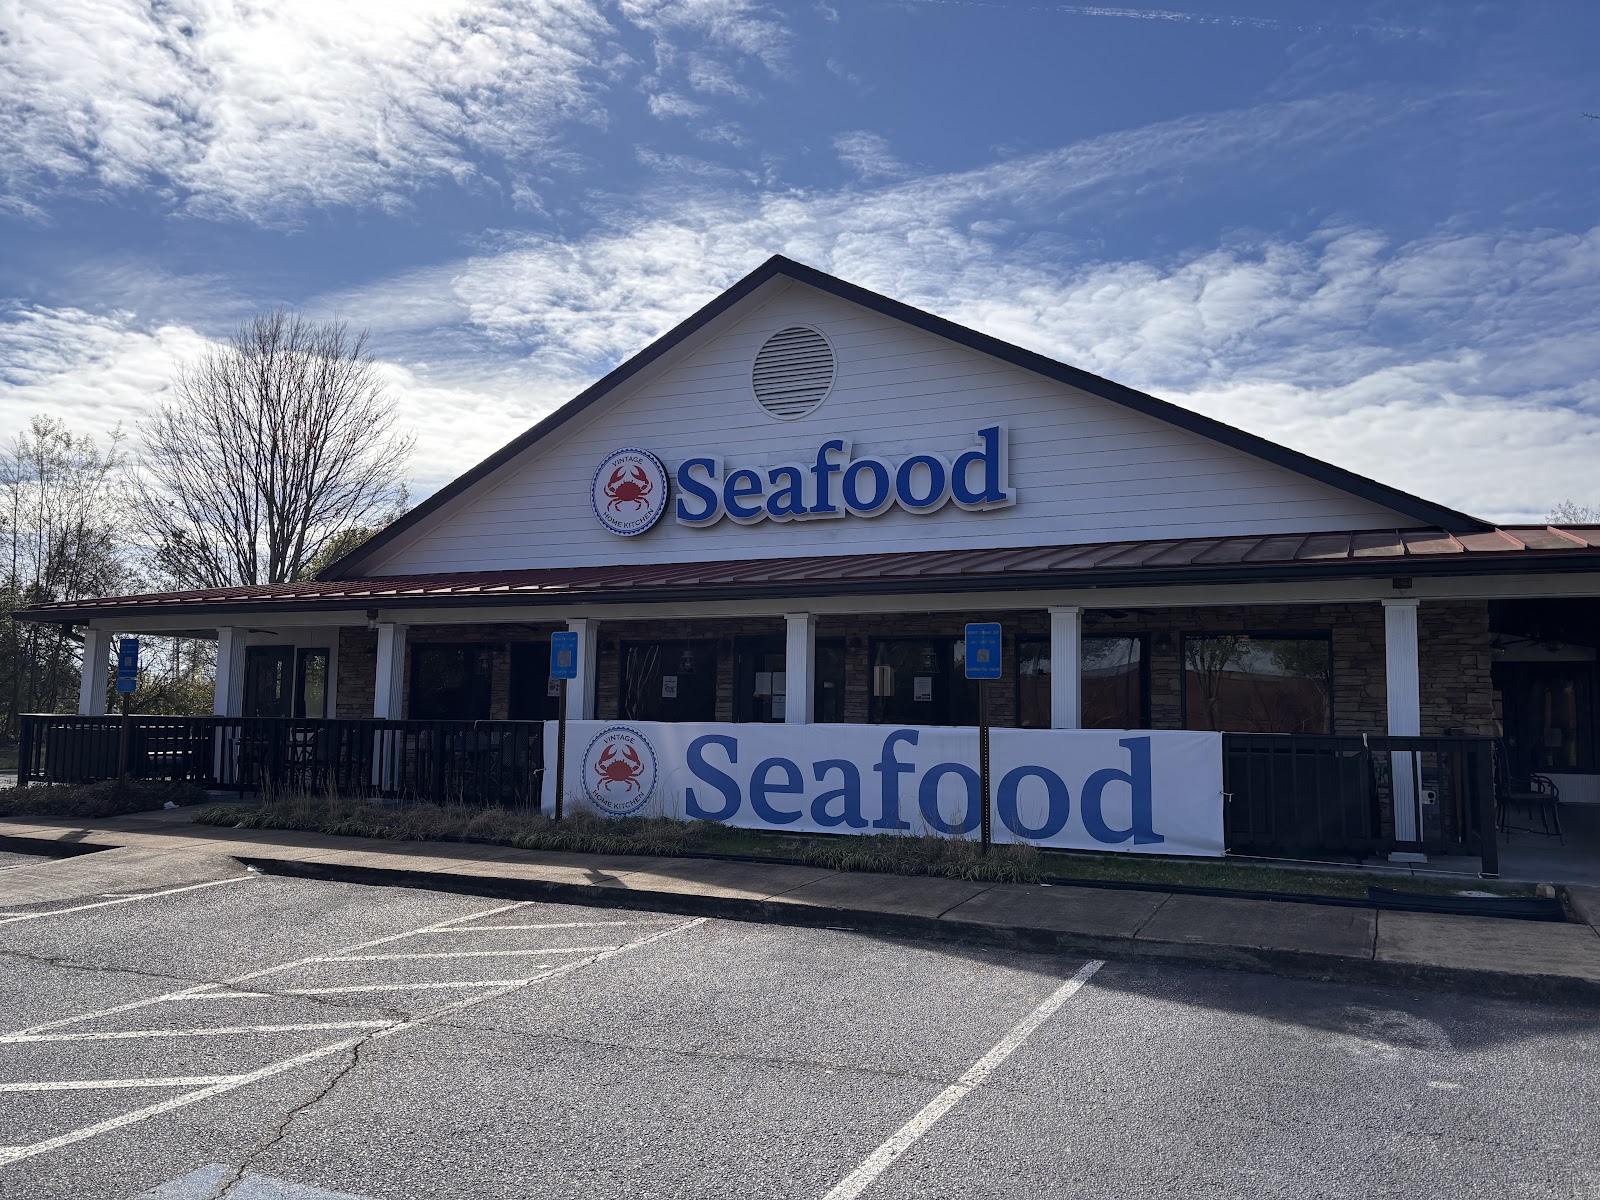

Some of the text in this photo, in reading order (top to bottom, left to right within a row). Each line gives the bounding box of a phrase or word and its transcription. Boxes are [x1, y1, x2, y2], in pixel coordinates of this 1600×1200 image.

[611, 456, 644, 467] VINTAGE
[677, 425, 1008, 523] Seafood
[602, 508, 654, 529] HOME KITCHEN
[603, 734, 636, 745] VINTAGE
[685, 729, 1165, 846] Seafood
[592, 789, 645, 810] HOME KITCHEN
